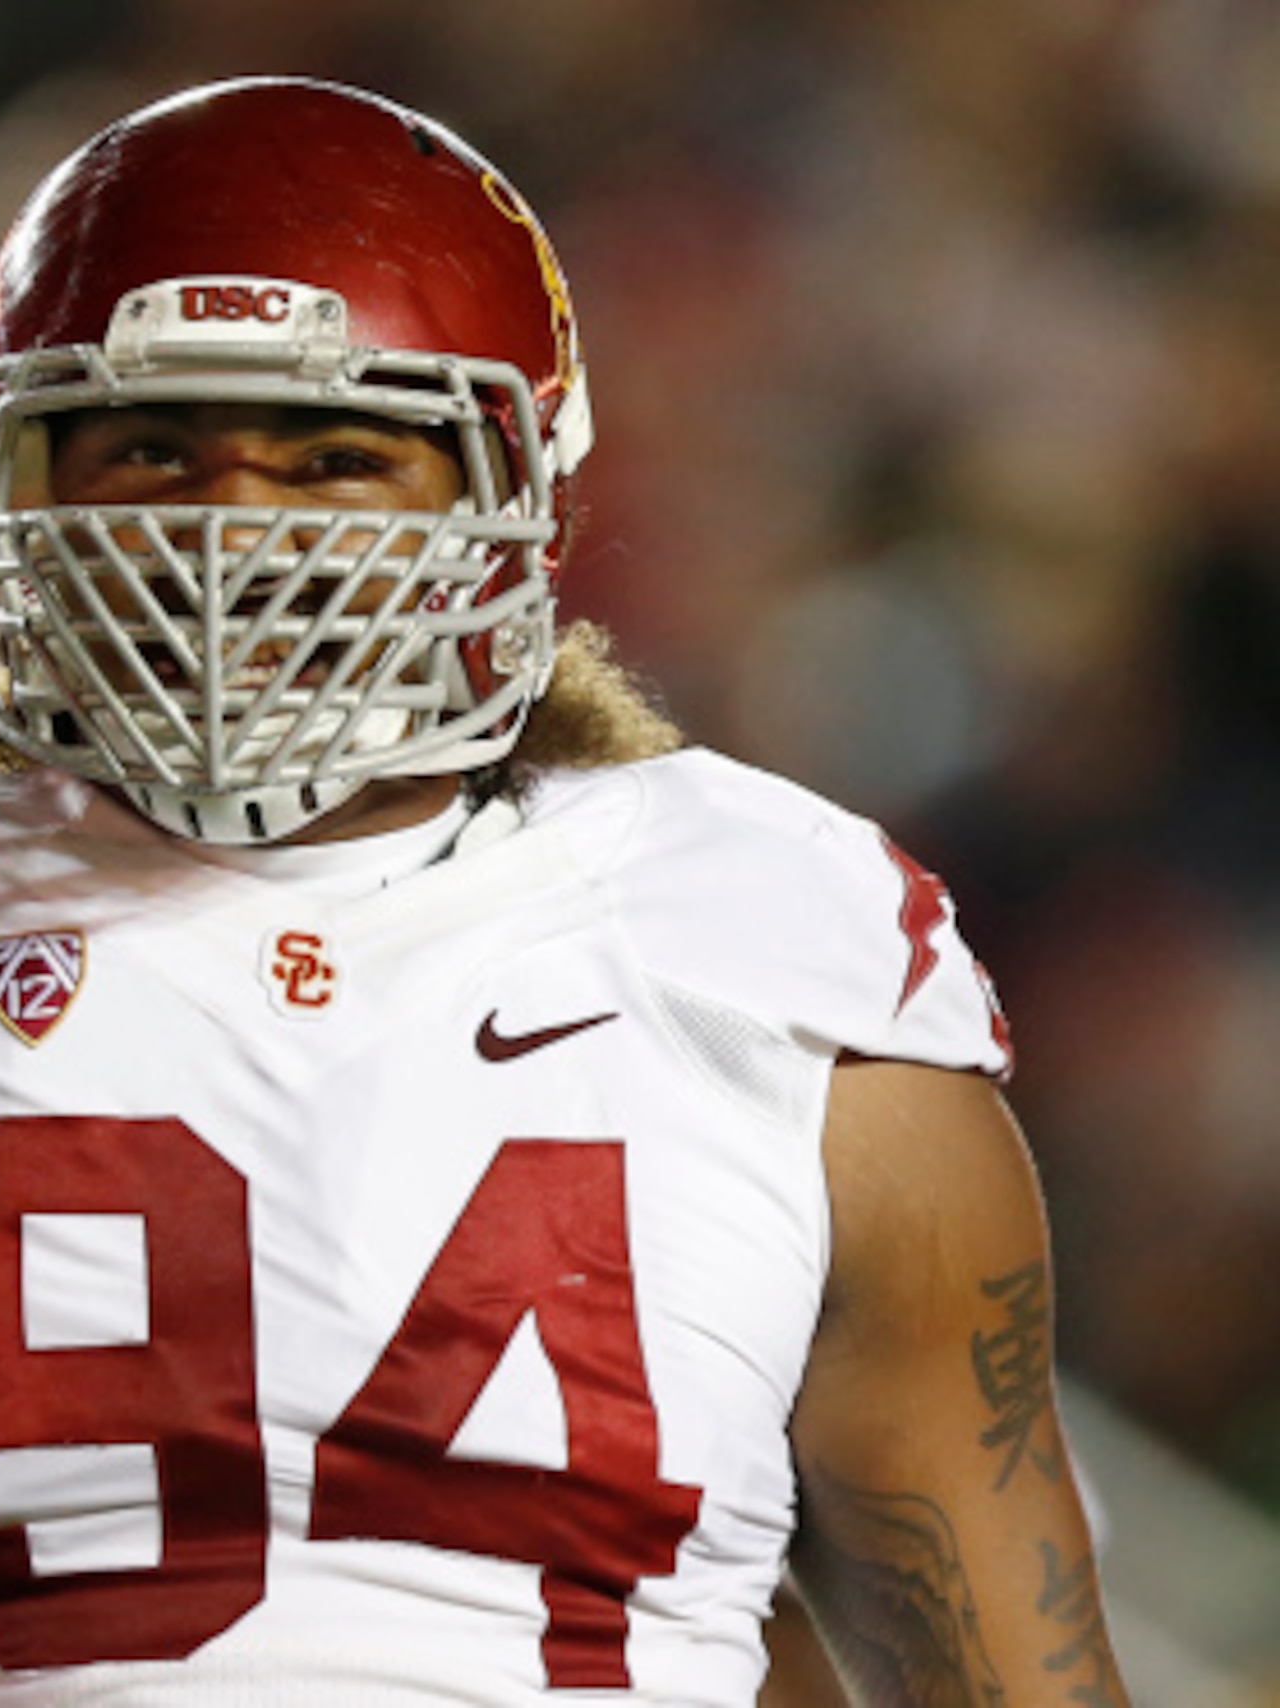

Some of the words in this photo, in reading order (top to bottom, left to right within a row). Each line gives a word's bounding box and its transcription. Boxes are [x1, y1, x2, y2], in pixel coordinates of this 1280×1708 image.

[180, 286, 290, 322] USC
[271, 930, 336, 1008] SC
[6, 973, 62, 1019] 12
